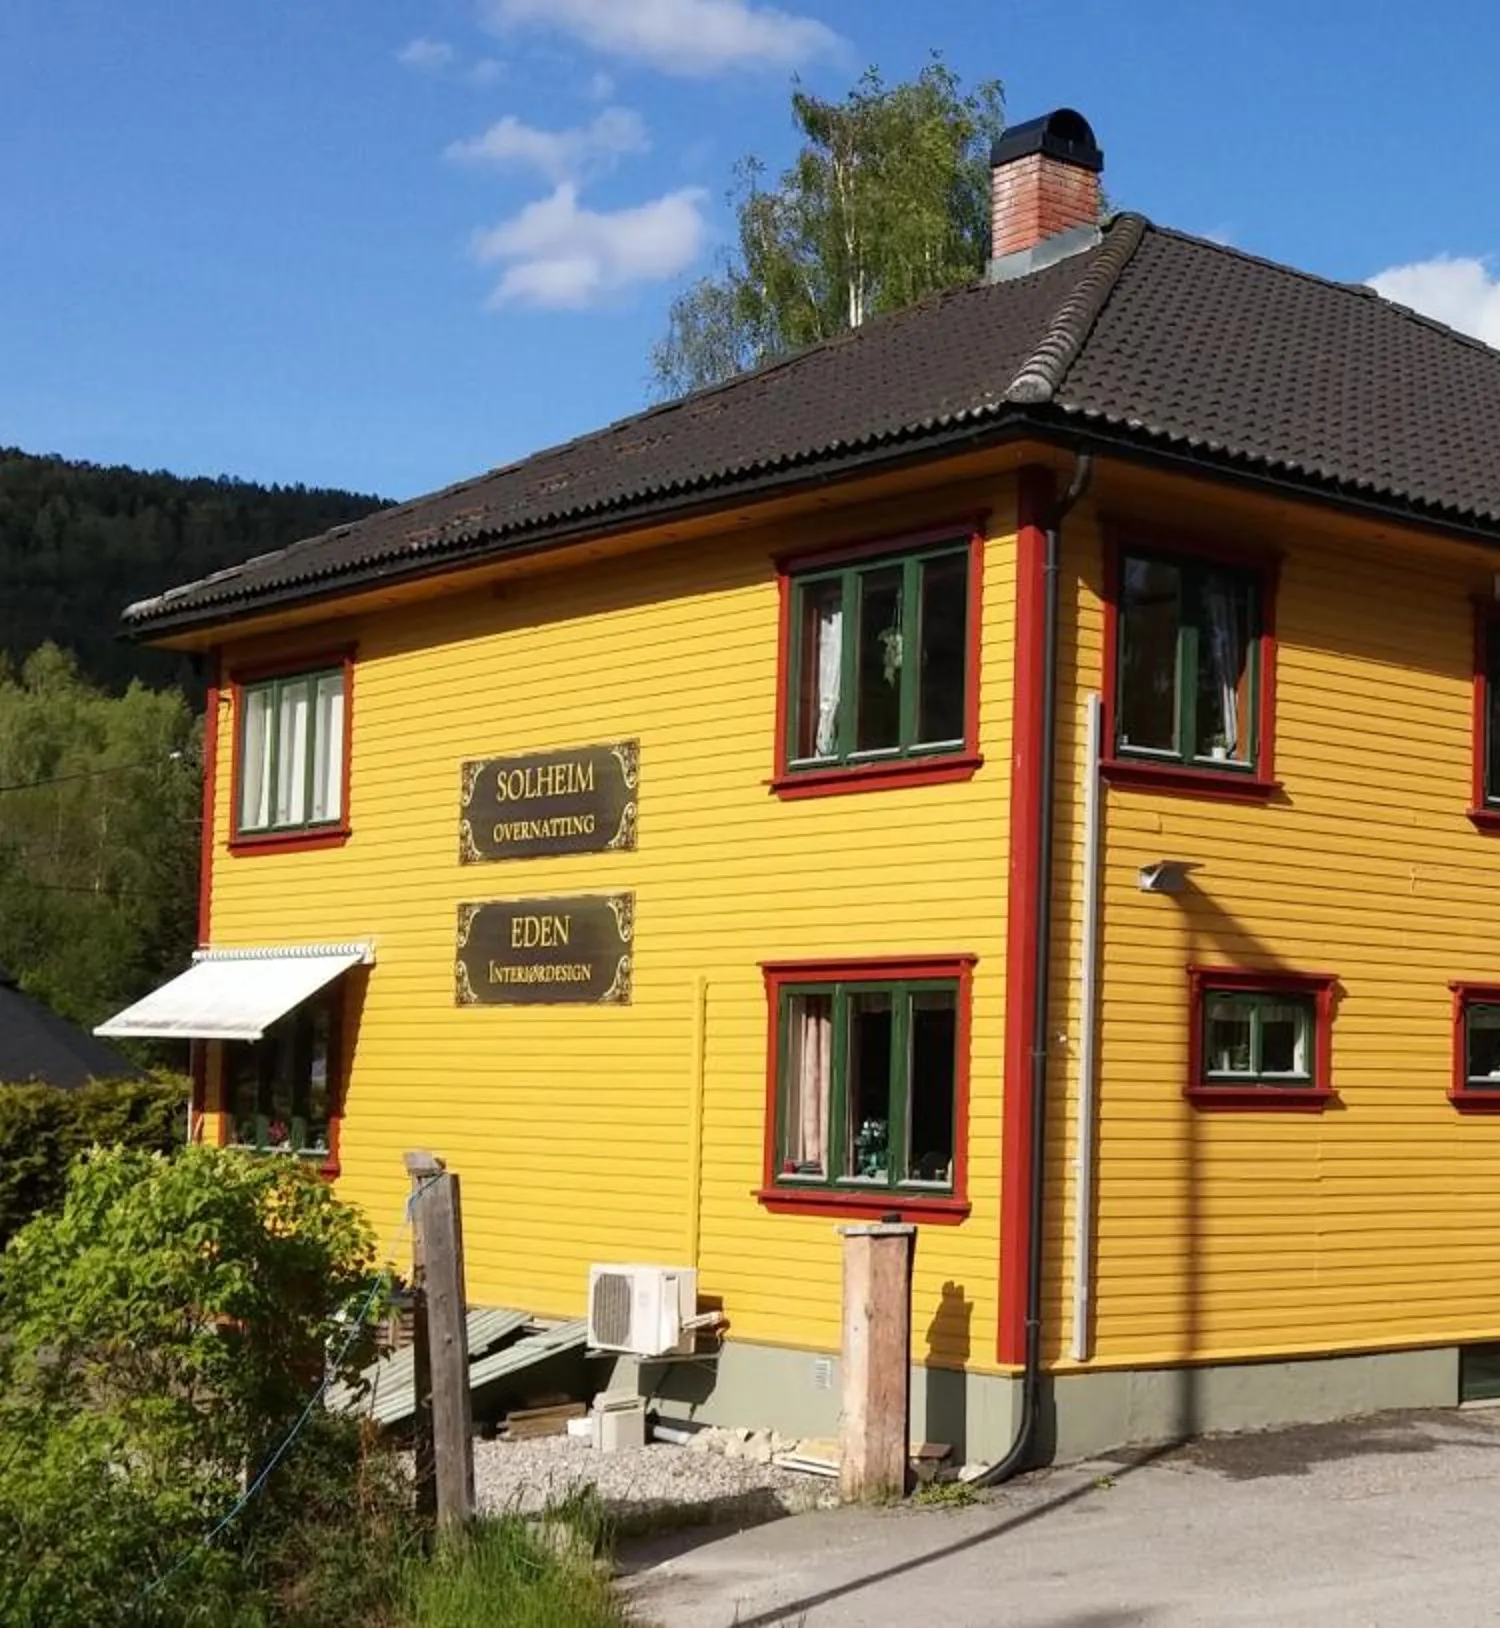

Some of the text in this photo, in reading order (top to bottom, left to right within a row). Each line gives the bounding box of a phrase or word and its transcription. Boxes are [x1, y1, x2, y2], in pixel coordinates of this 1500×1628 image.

[496, 762, 595, 802] SOLHEIM
[493, 814, 596, 843] OVERNATTING
[511, 915, 571, 948] EDEN
